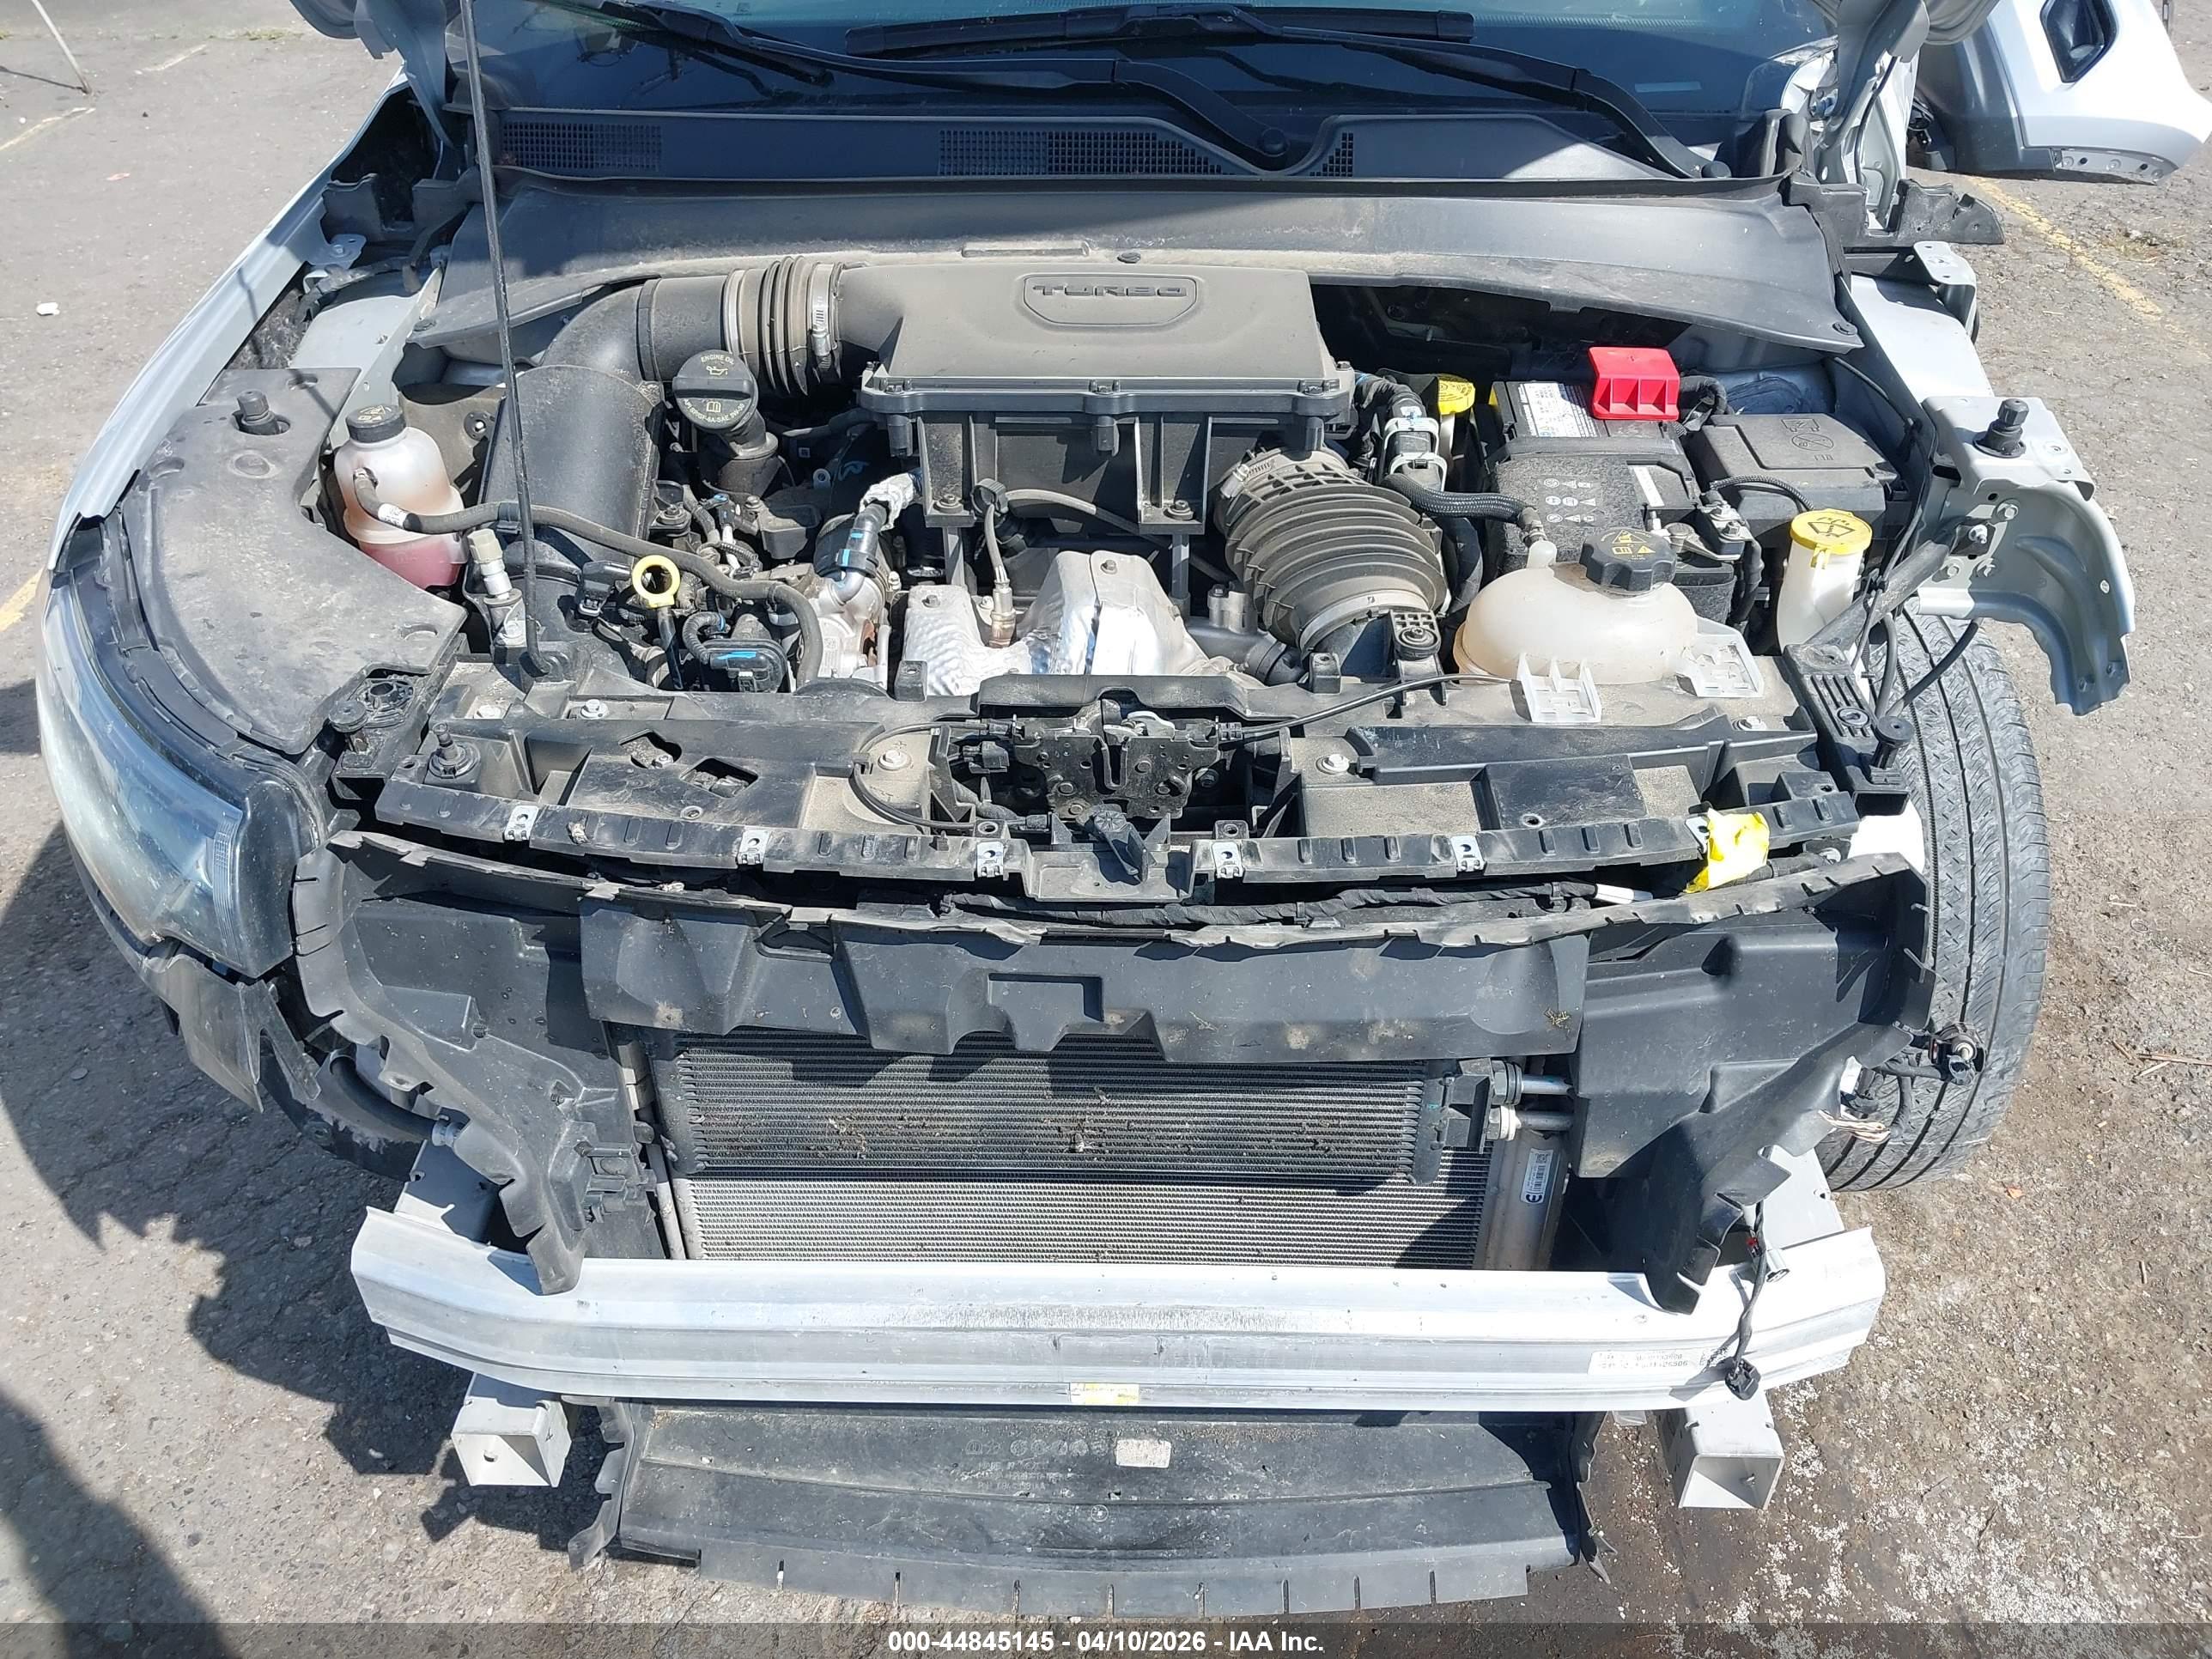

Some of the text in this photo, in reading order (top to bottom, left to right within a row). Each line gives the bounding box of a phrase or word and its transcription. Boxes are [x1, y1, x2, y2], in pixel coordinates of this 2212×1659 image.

[1033, 285, 1187, 297] TURBO
[701, 354, 734, 365] ENGINE OIL
